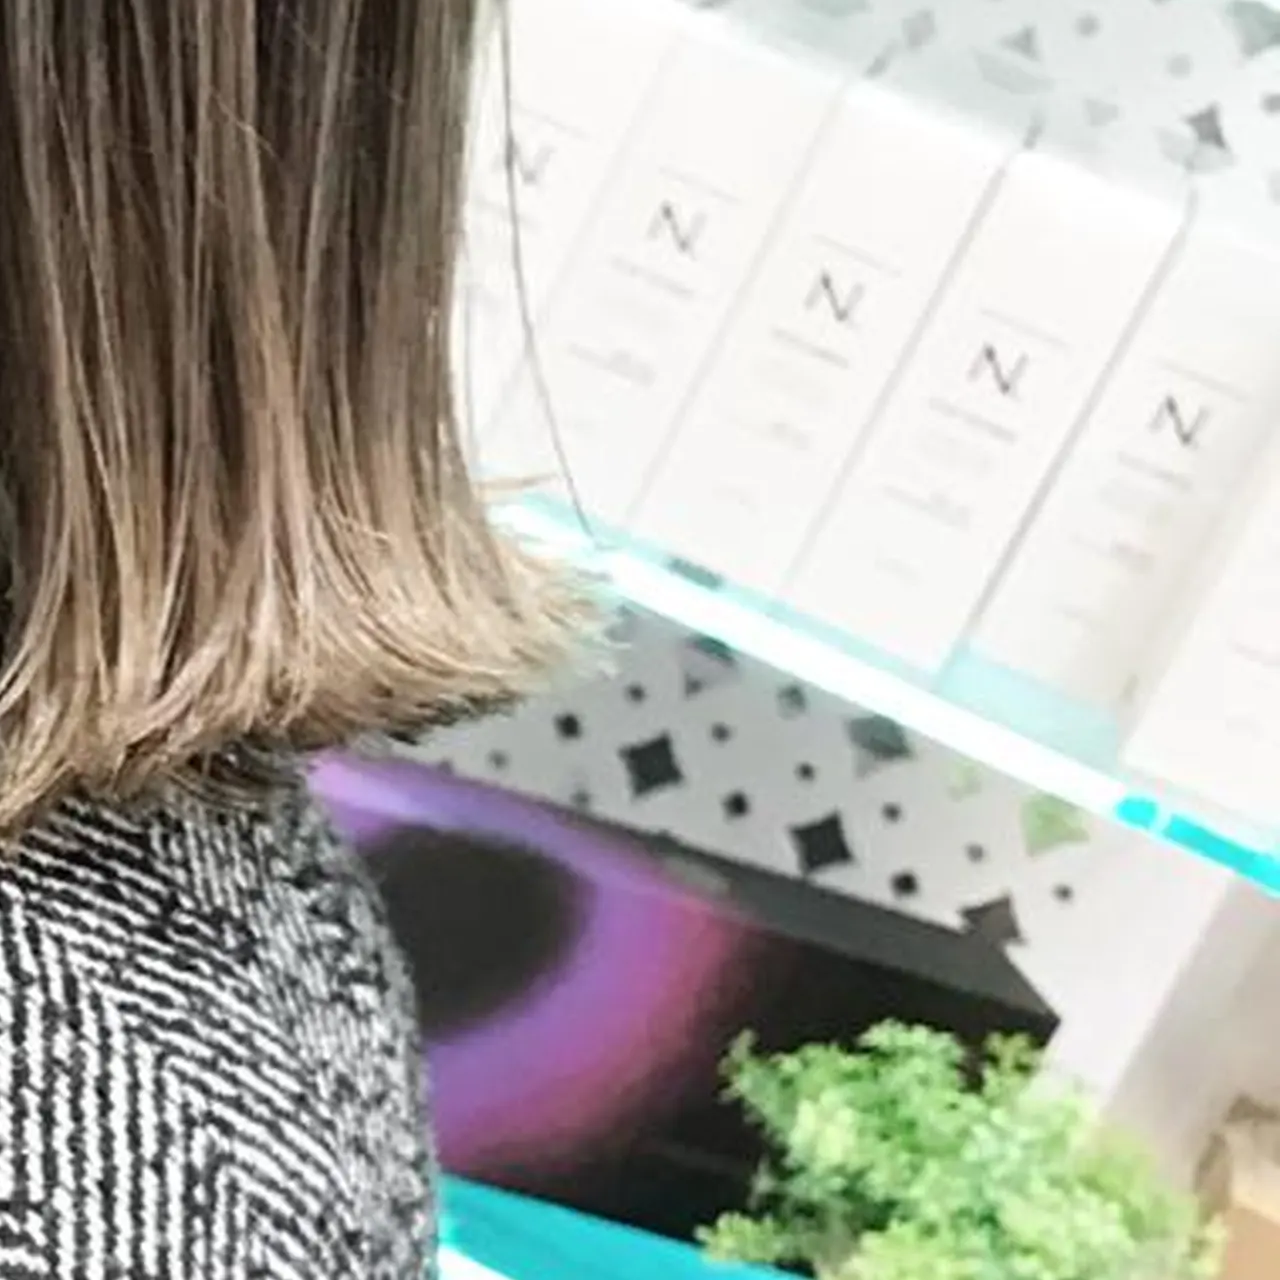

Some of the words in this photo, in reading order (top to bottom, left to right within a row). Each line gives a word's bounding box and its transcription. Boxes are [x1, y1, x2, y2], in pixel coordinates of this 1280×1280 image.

[648, 200, 708, 253] N
[804, 272, 865, 323] N
[969, 343, 1028, 394] N
[1148, 395, 1210, 446] N
